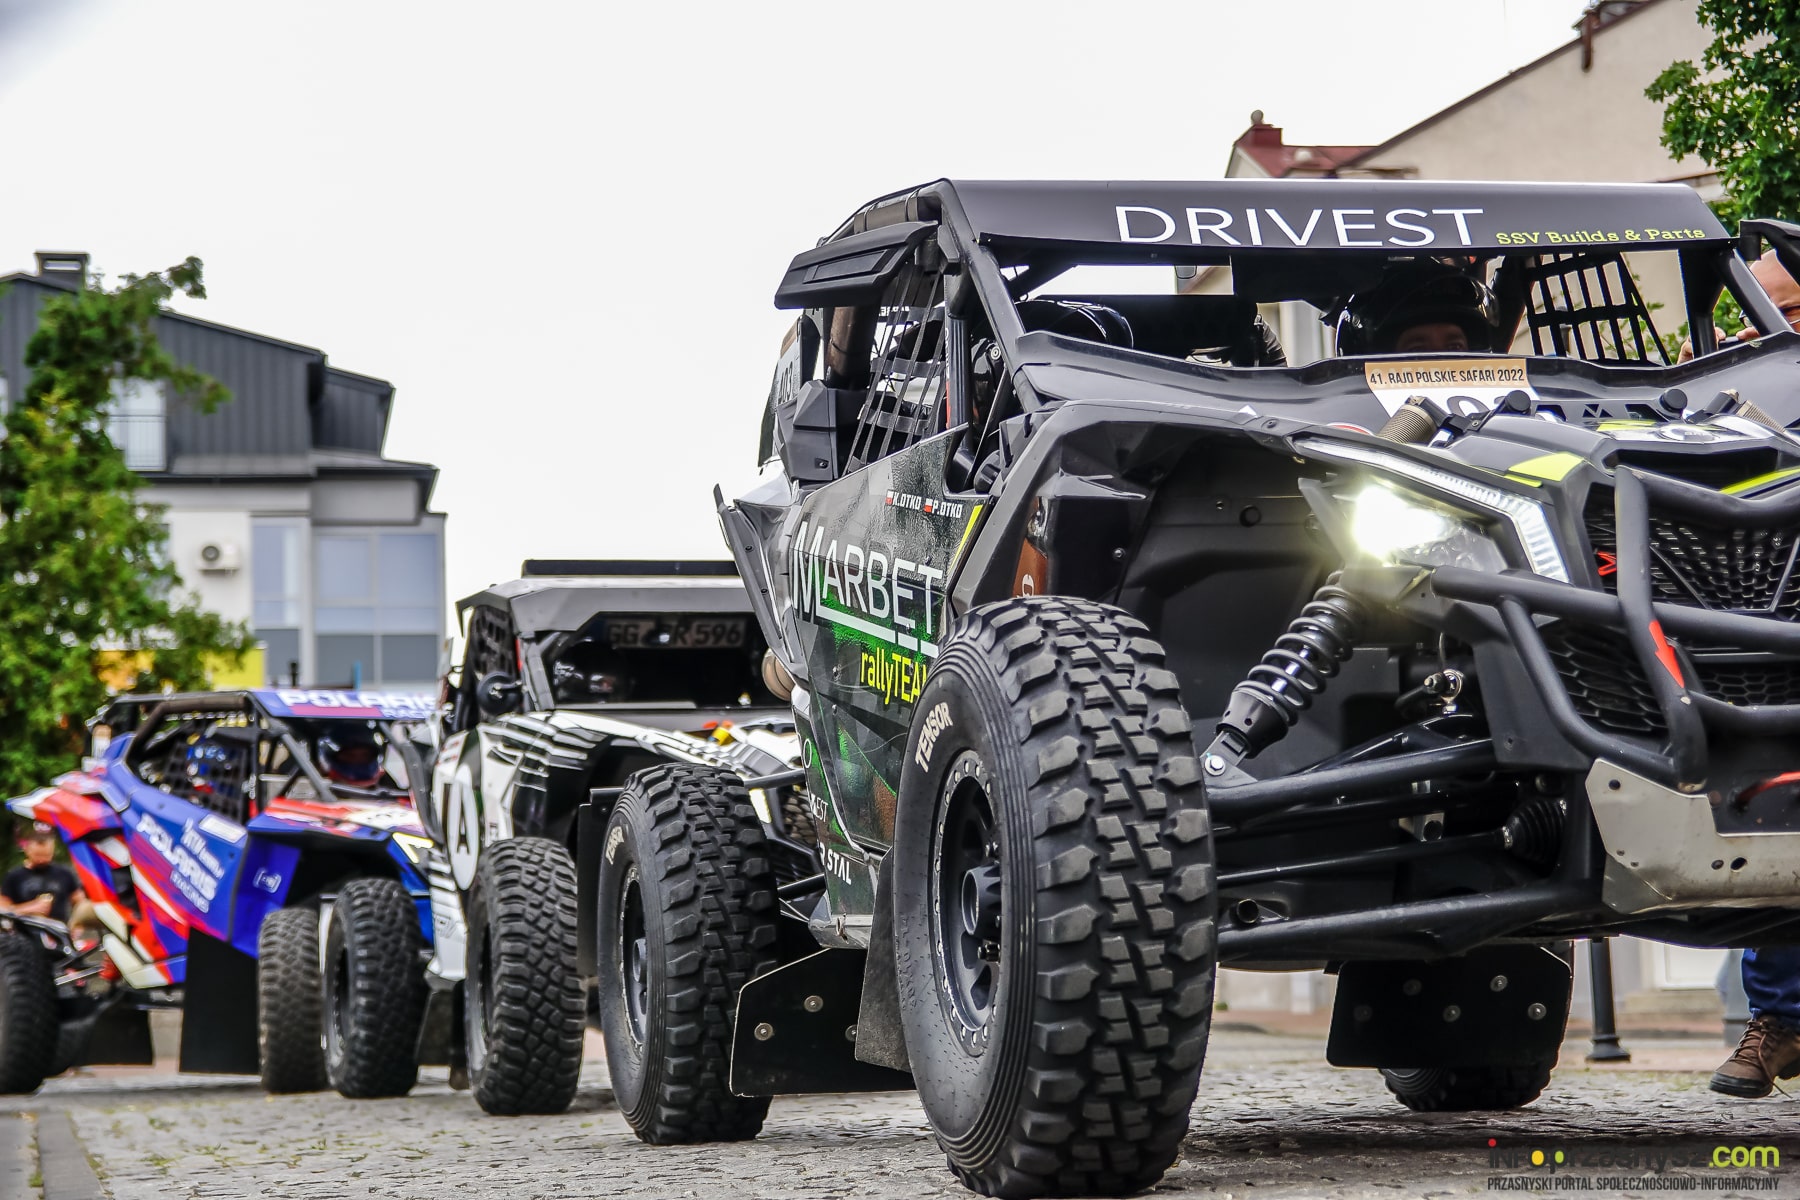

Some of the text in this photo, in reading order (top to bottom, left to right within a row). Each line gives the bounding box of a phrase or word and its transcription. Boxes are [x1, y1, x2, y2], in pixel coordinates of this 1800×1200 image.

[1115, 205, 1484, 247] DRIVEST
[1495, 228, 1706, 245] SSV Builds & Parts
[1370, 369, 1525, 385] 41. RAJD POLSKIE SAFARI 2022
[931, 501, 964, 519] P.OTKO
[793, 521, 943, 636] MARBET
[694, 623, 742, 646] 596
[914, 702, 954, 773] TENSOR
[827, 849, 852, 885] STAL
